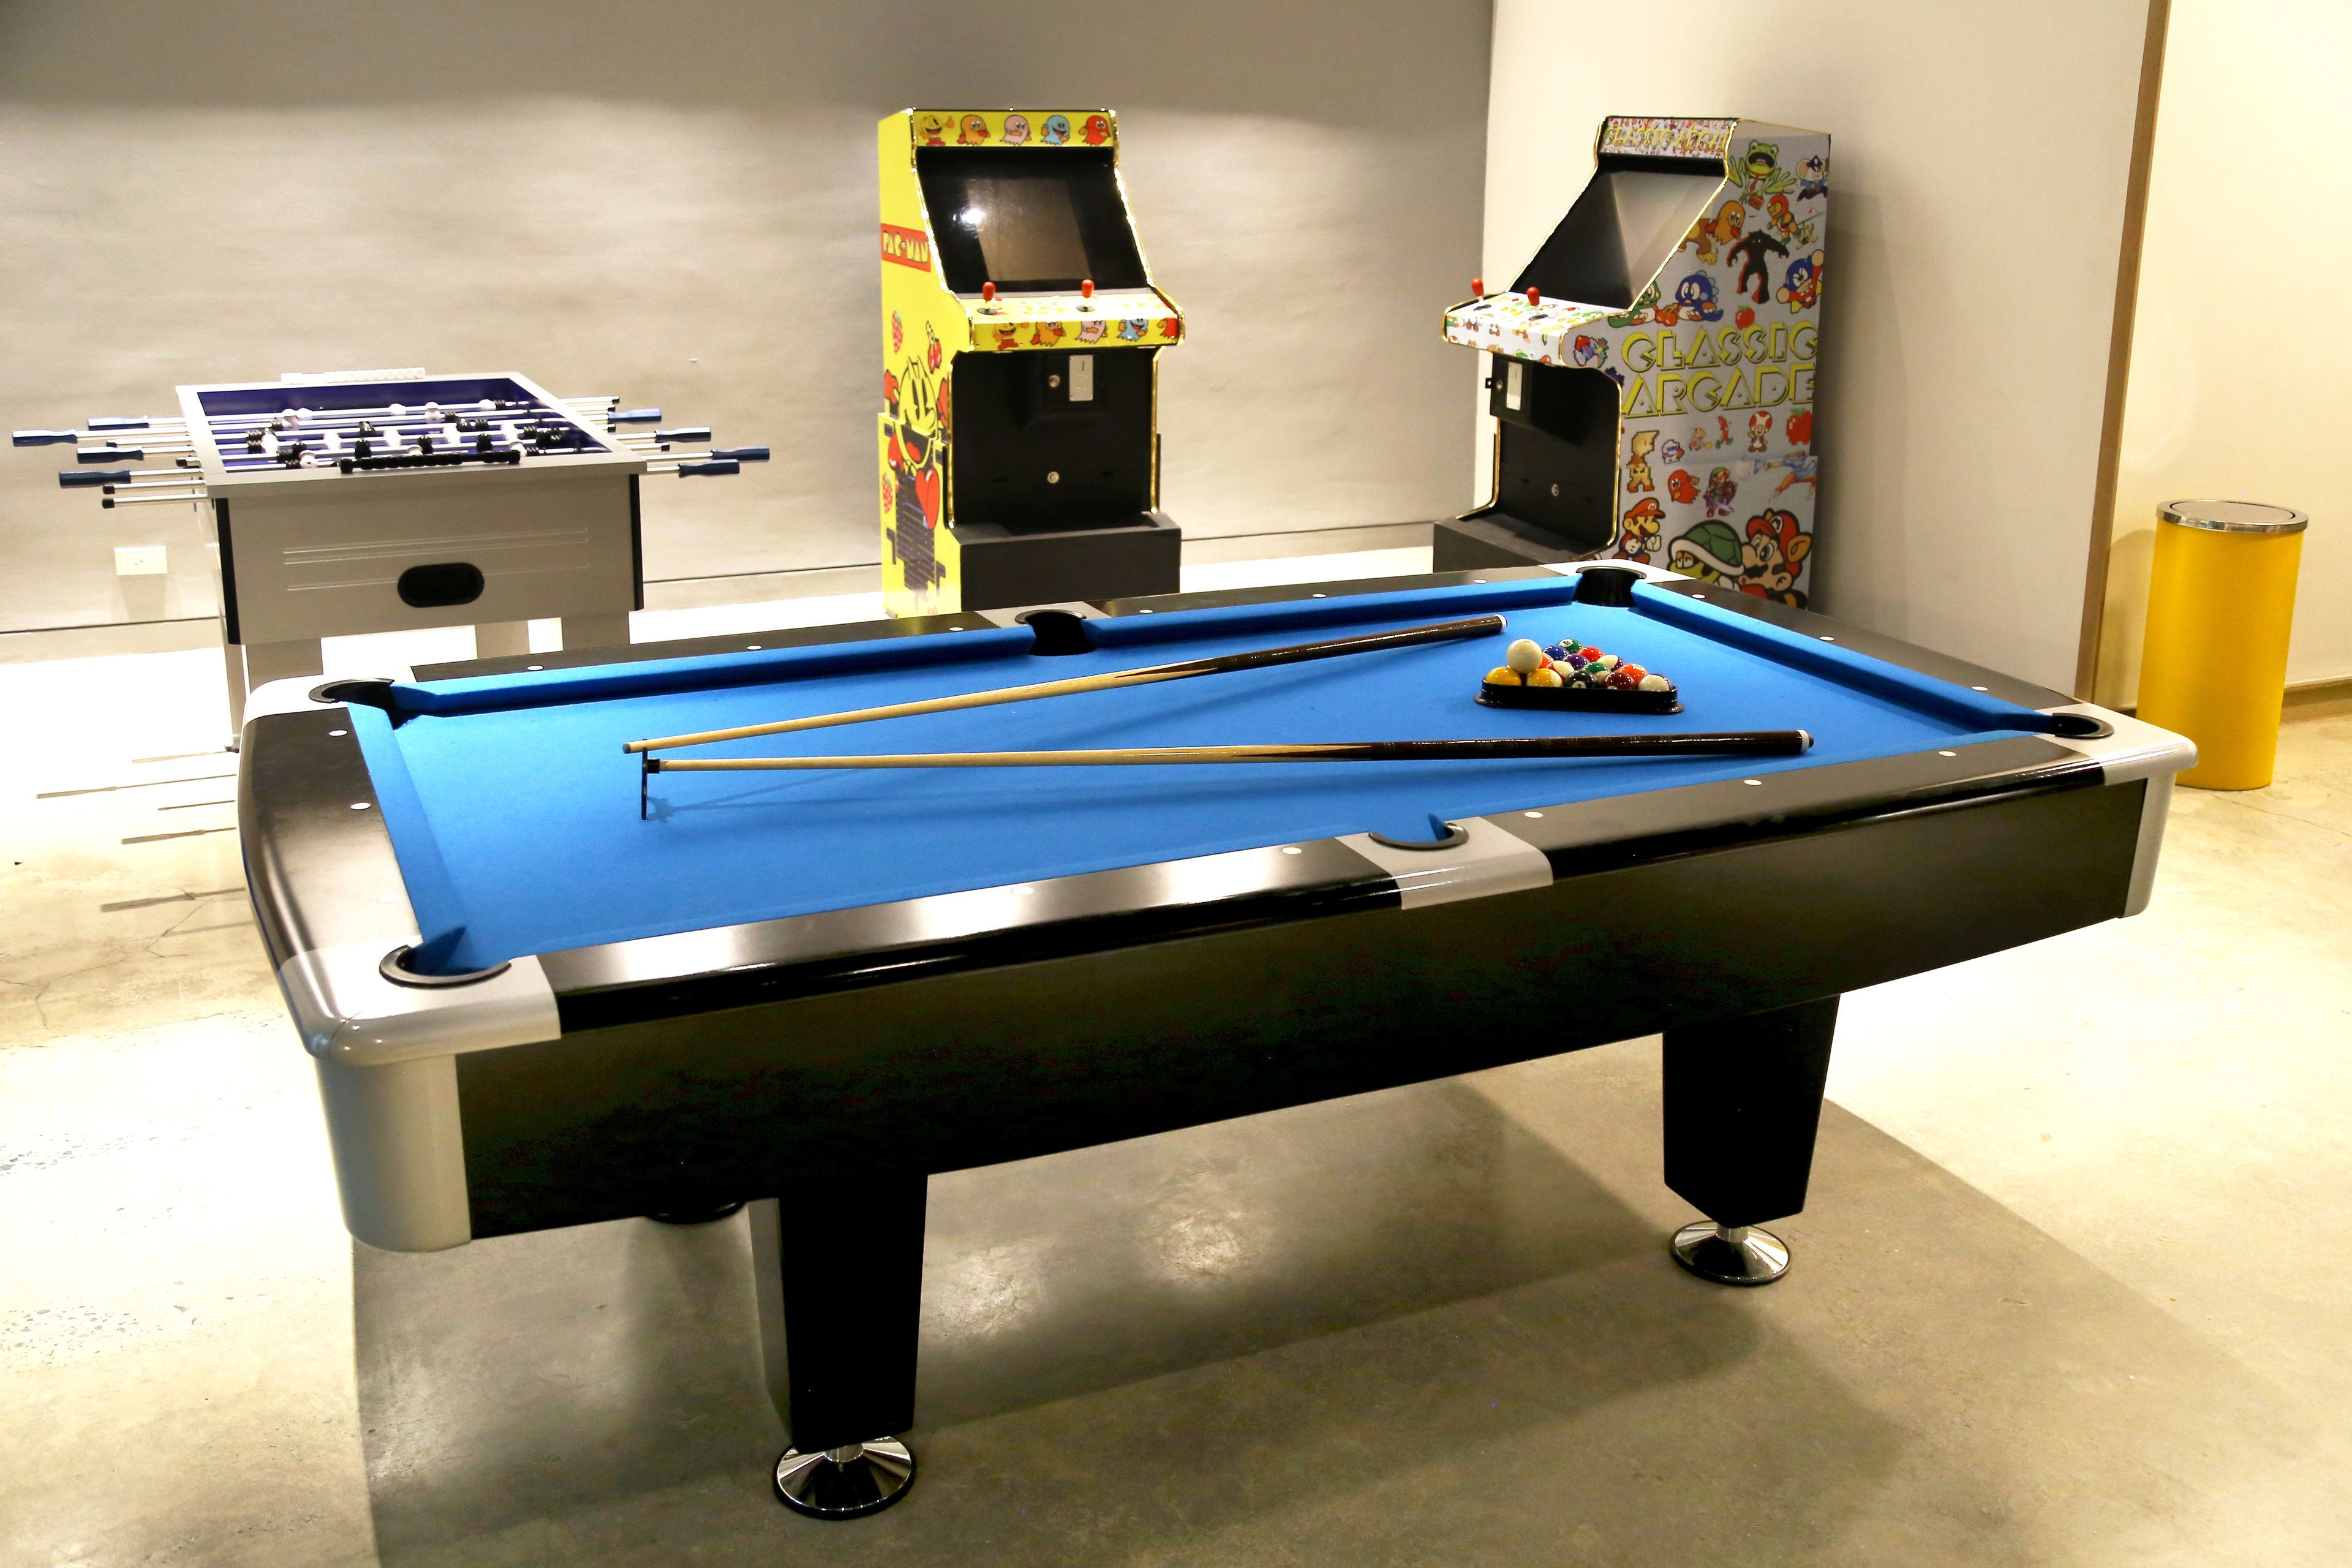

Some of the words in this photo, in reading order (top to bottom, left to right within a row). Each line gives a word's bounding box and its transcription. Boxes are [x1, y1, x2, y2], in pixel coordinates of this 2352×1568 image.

[1603, 126, 1673, 150] CLASSIC
[1673, 128, 1729, 153] ARCA
[883, 230, 929, 263] PAC-MAN
[1621, 320, 1818, 372] CLASSIC
[1621, 363, 1815, 419] ARCADE
